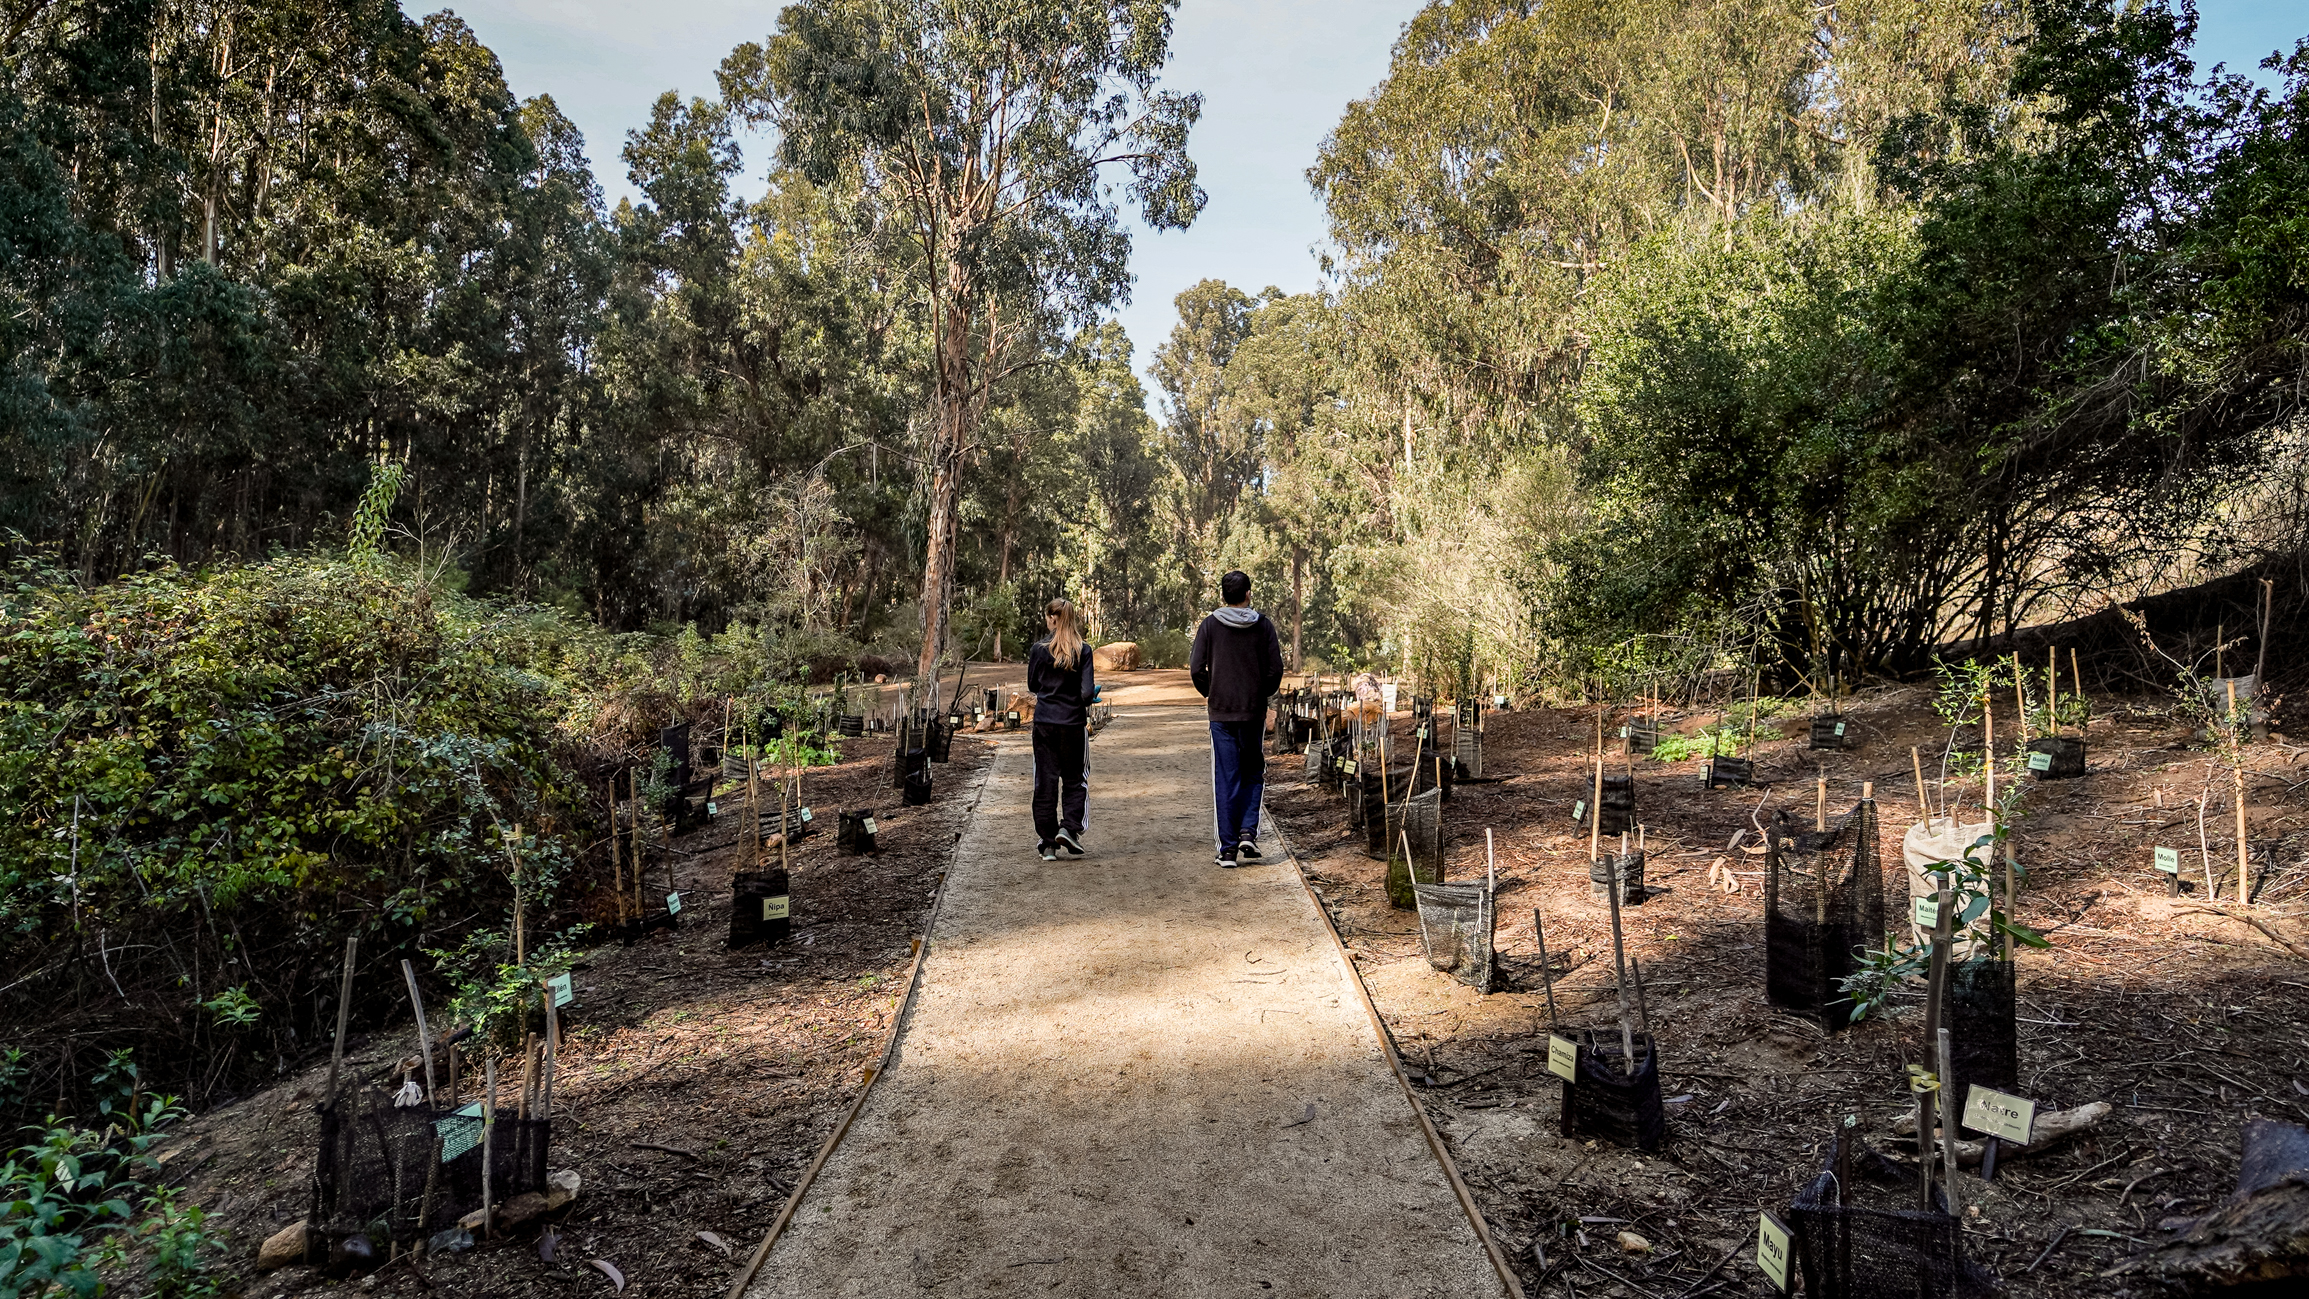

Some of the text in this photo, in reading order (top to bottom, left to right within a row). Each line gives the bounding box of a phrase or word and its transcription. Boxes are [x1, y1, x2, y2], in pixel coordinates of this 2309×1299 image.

[2157, 853, 2175, 863] Molle
[768, 902, 785, 911] Ñipa
[1919, 904, 1937, 914] Maité
[555, 983, 568, 994] ilén
[1551, 1045, 1574, 1063] Chamiza
[1981, 1099, 2020, 1120] Natre
[1763, 1230, 1783, 1261] Mayu
